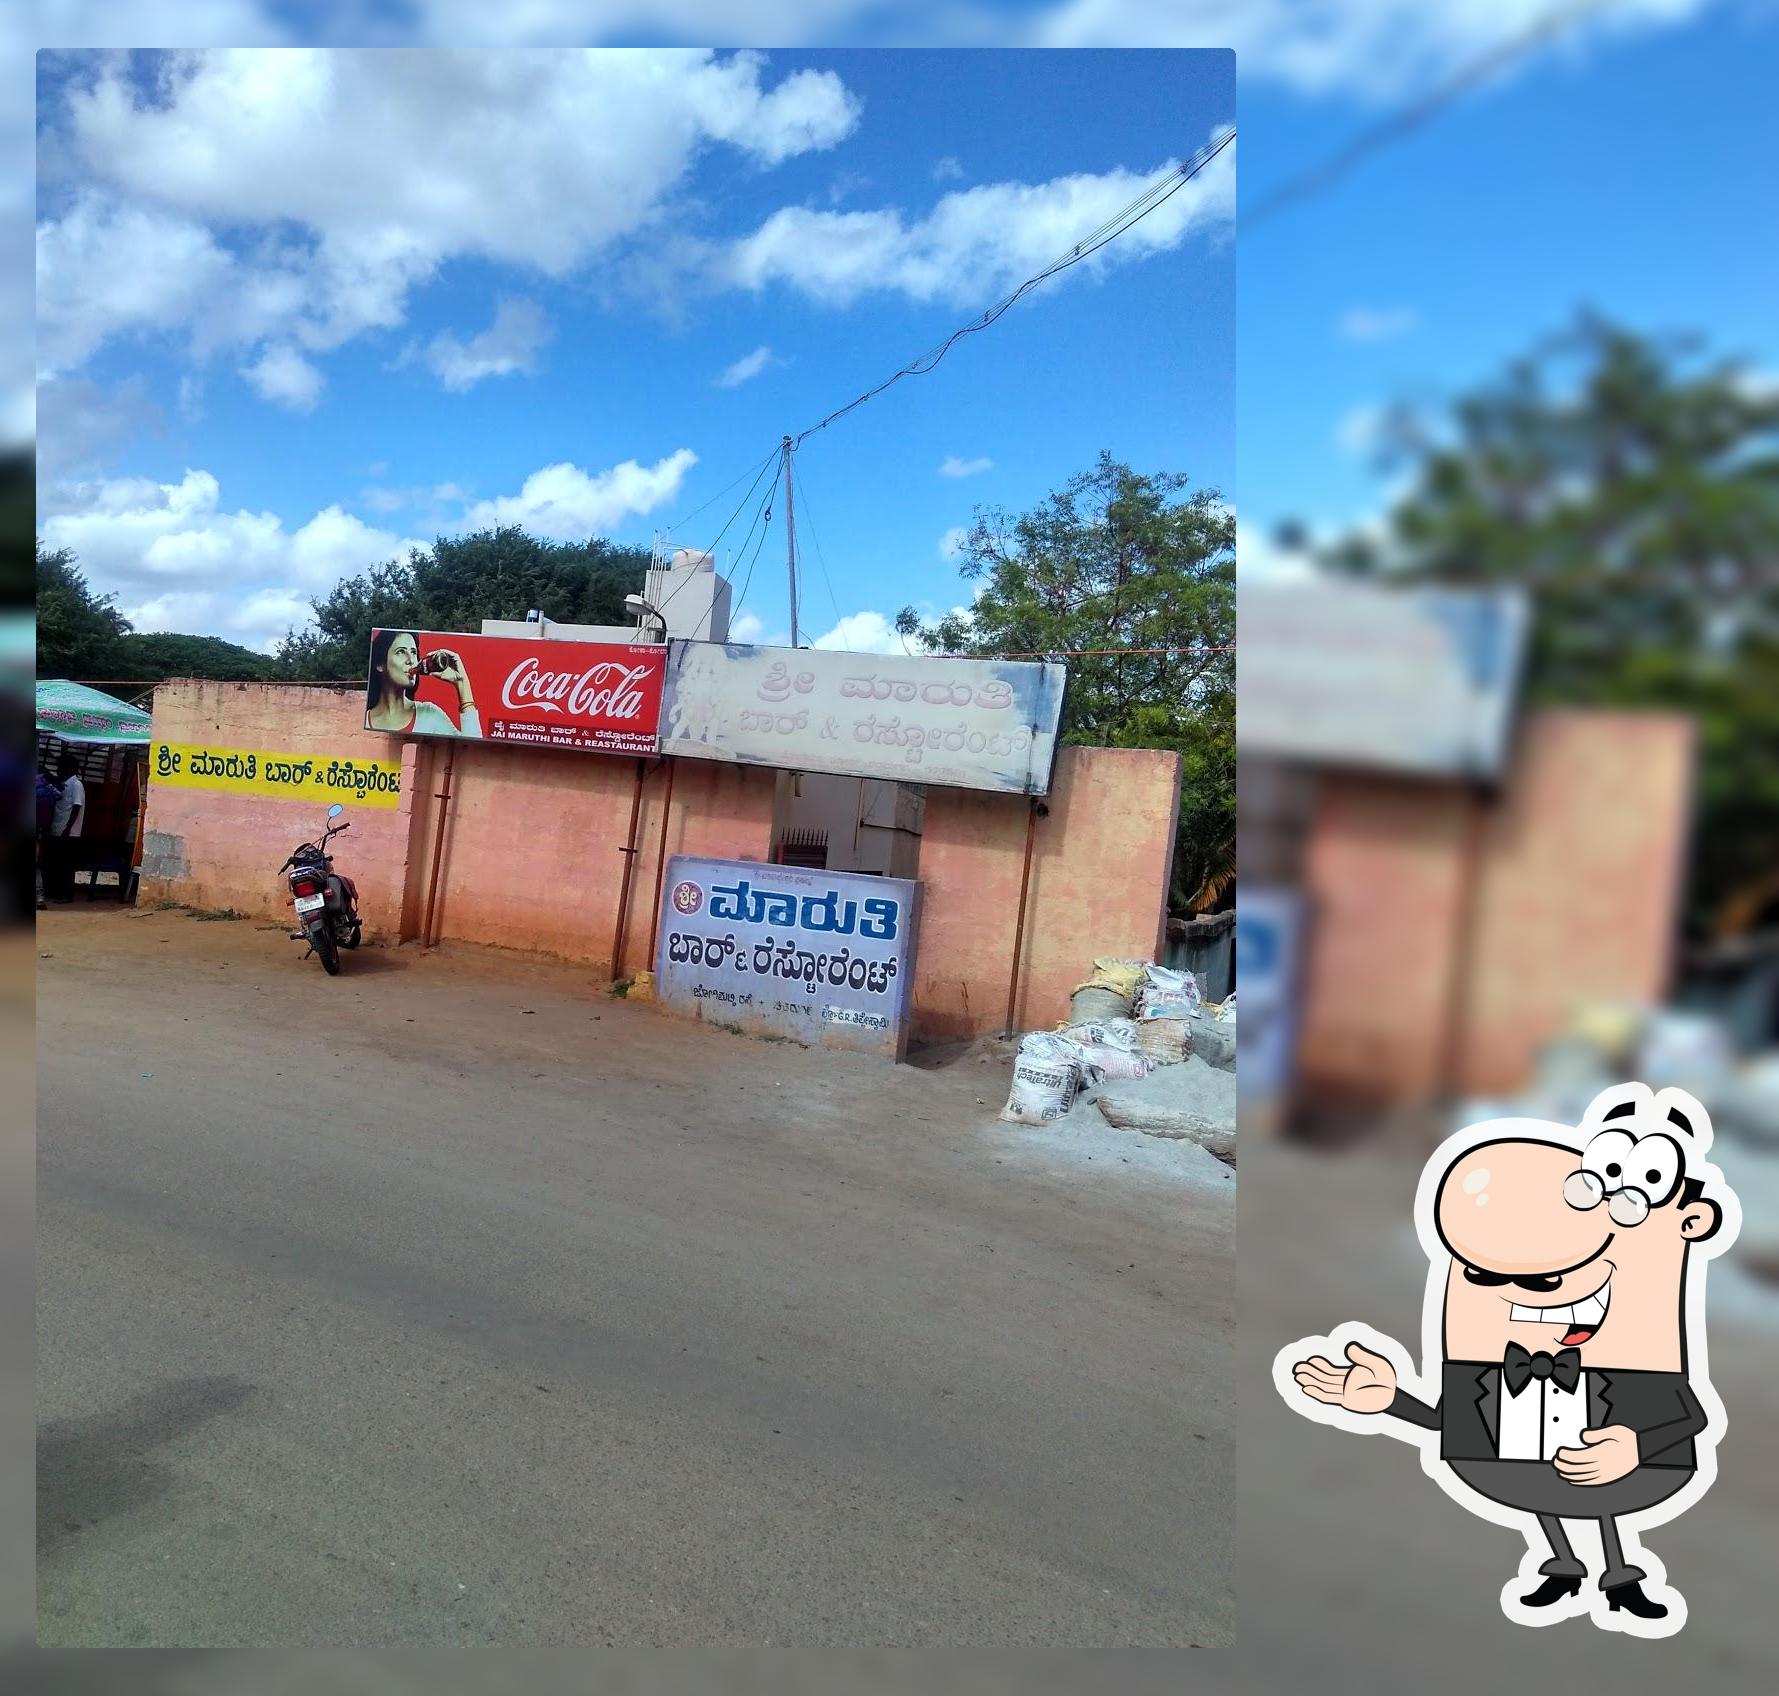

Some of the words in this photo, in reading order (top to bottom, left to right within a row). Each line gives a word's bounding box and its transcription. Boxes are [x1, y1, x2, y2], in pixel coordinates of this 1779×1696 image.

[501, 657, 656, 720] Coca-Cola
[757, 661, 815, 702] ಶ್ರೀ
[840, 673, 1015, 711] ಮಾರುತಿ
[491, 731, 505, 739] JAI
[508, 732, 550, 743] MARUTHI
[552, 737, 572, 745] BAR
[574, 738, 582, 746] &
[585, 740, 656, 753] REASTAURANT
[582, 729, 590, 737] &
[739, 707, 809, 735] ಬಾರ್
[820, 716, 838, 740] &
[157, 745, 181, 776] ಶ್ರೀ
[190, 750, 256, 780] ಮಾರುತಿ
[265, 760, 312, 785] ಬಾರ್
[315, 771, 324, 784] &
[680, 884, 697, 909] ಶ್ರೀ
[709, 881, 899, 940] ಮಾರುತಿ
[669, 931, 735, 969] ಬಾರ್
